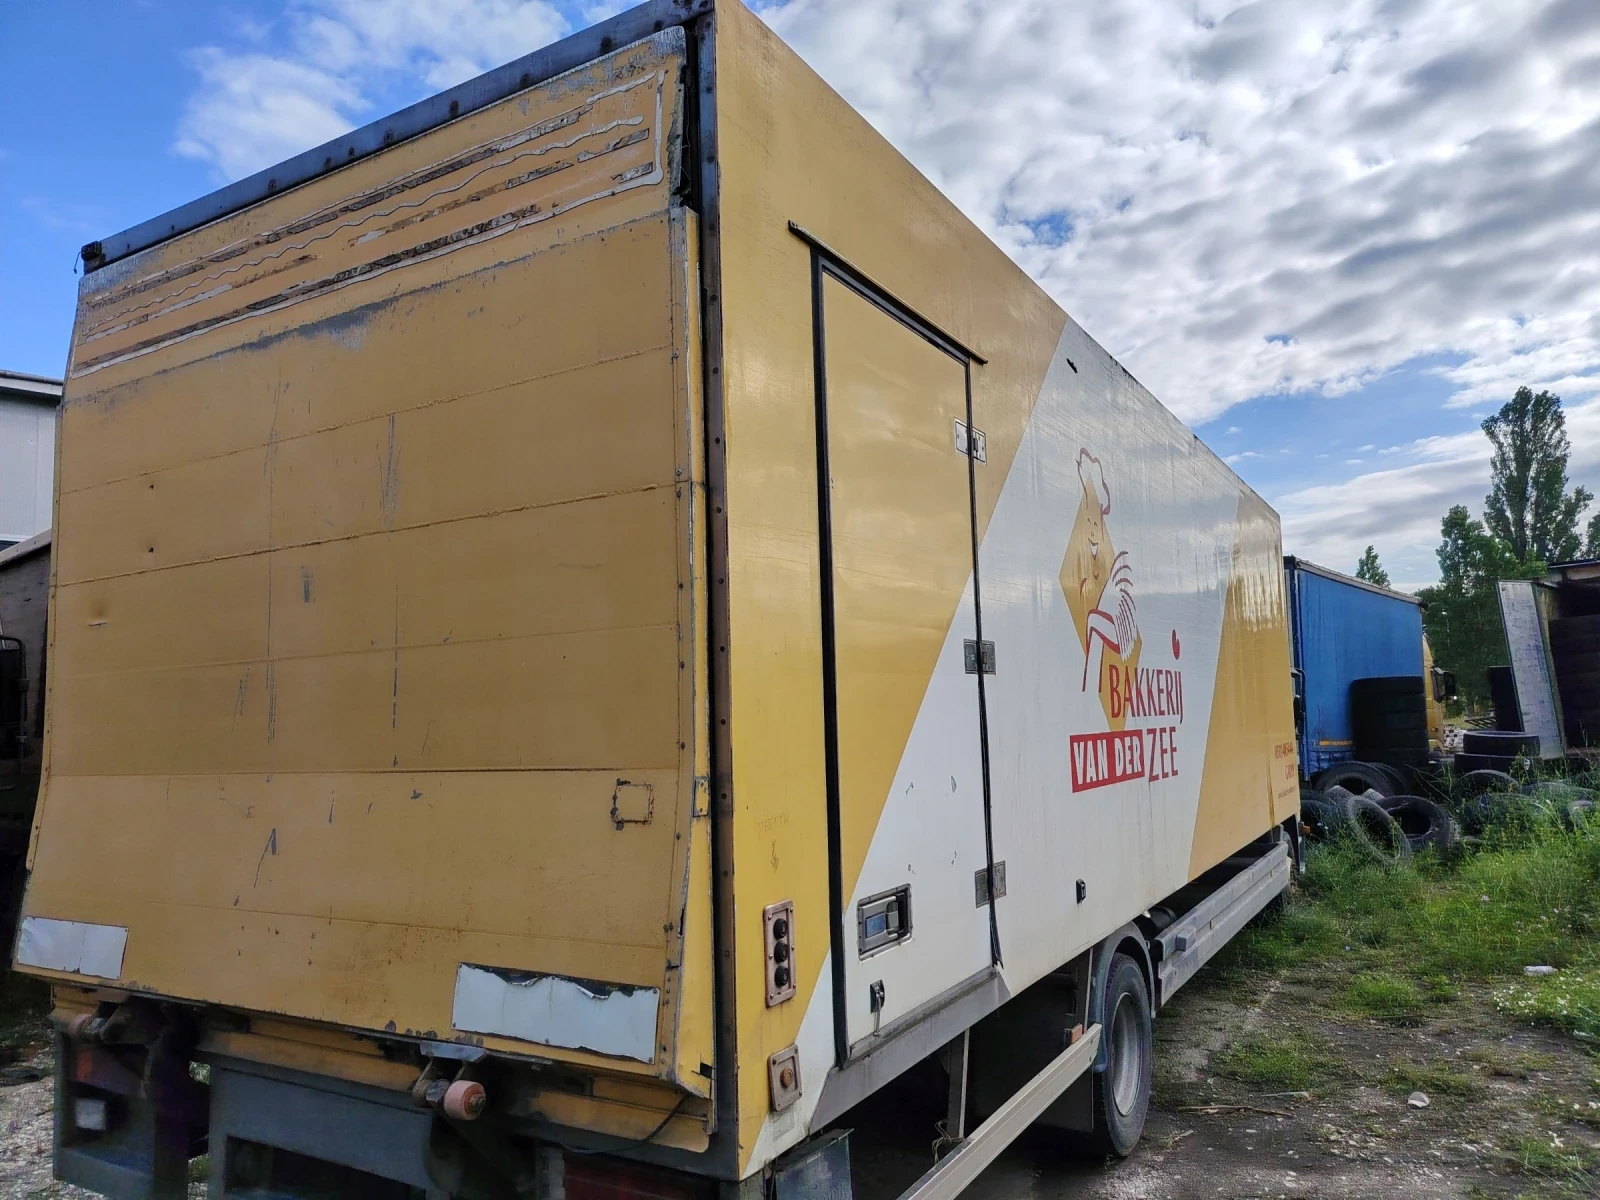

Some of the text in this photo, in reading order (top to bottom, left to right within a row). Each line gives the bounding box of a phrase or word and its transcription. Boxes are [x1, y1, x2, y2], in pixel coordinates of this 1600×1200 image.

[1109, 664, 1183, 724] BAKKERIJ
[1073, 726, 1179, 785] VAN DER ZEE
